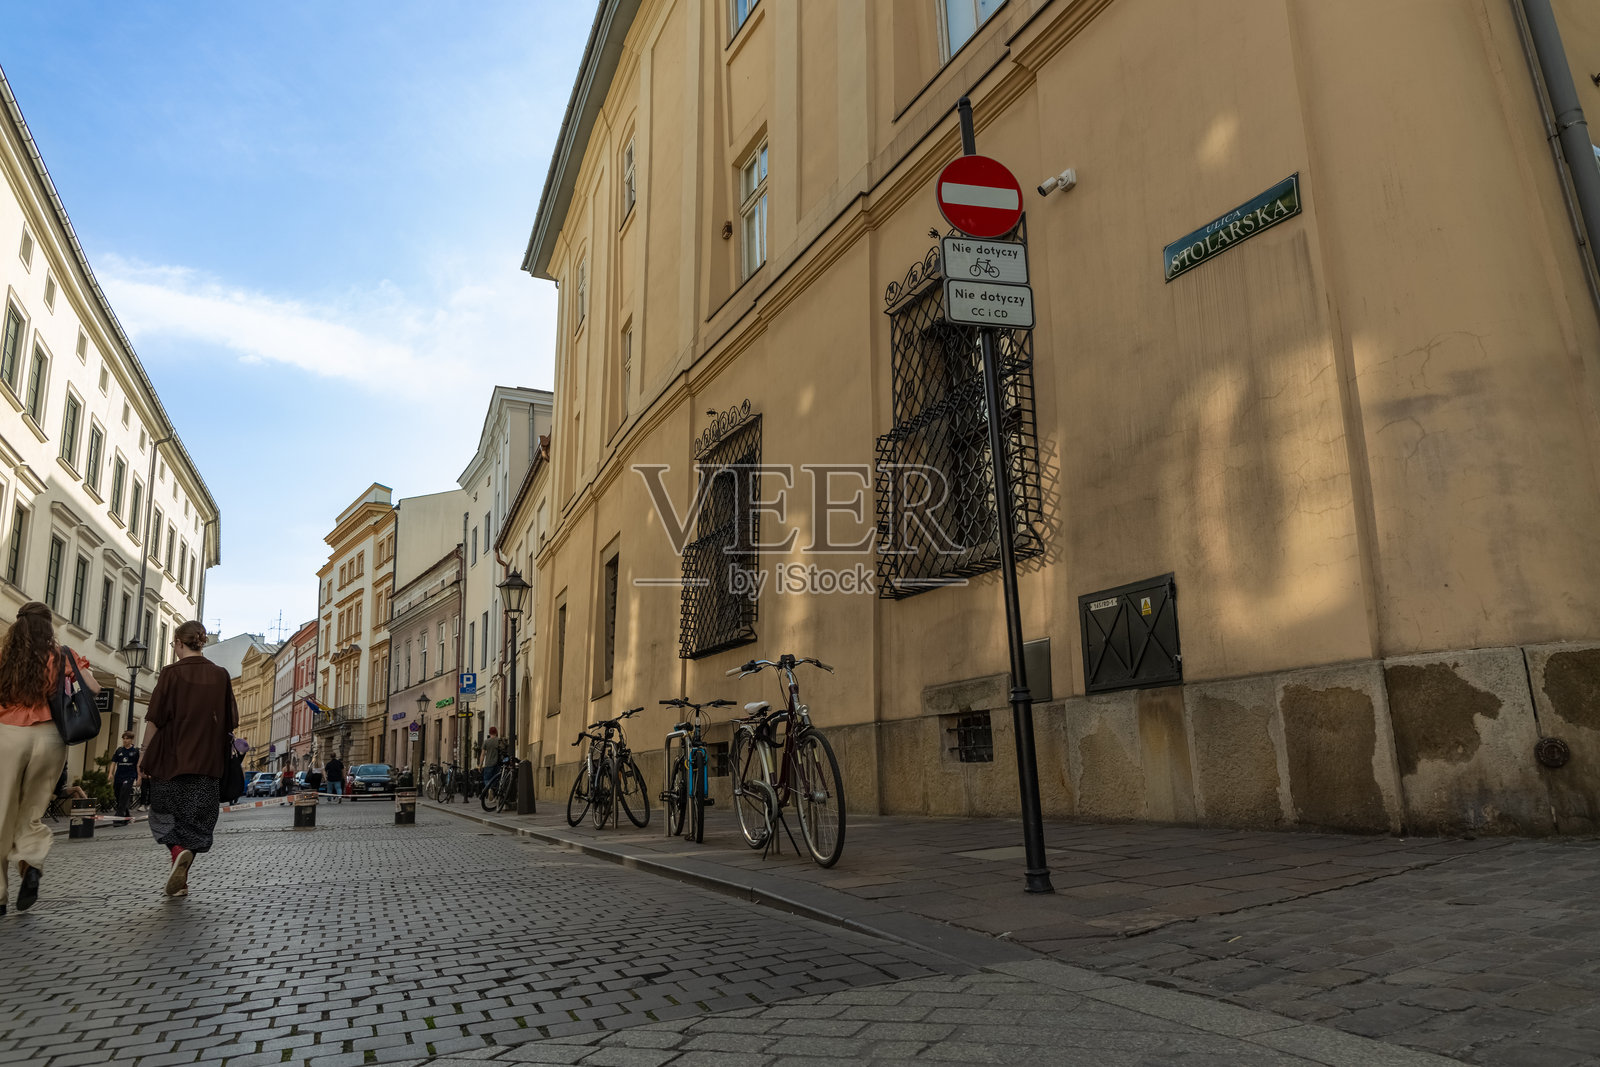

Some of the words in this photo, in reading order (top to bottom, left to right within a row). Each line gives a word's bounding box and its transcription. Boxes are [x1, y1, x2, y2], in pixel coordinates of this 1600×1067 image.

[1206, 210, 1241, 233] ULICA
[1171, 199, 1289, 272] STOLARSKA
[952, 242, 972, 254] Nie
[976, 245, 1018, 259] dotyczy
[955, 288, 975, 299] Nie
[980, 291, 1025, 307] dotyczy
[971, 307, 985, 316] CC
[994, 309, 1008, 318] CD
[463, 675, 473, 688] P
